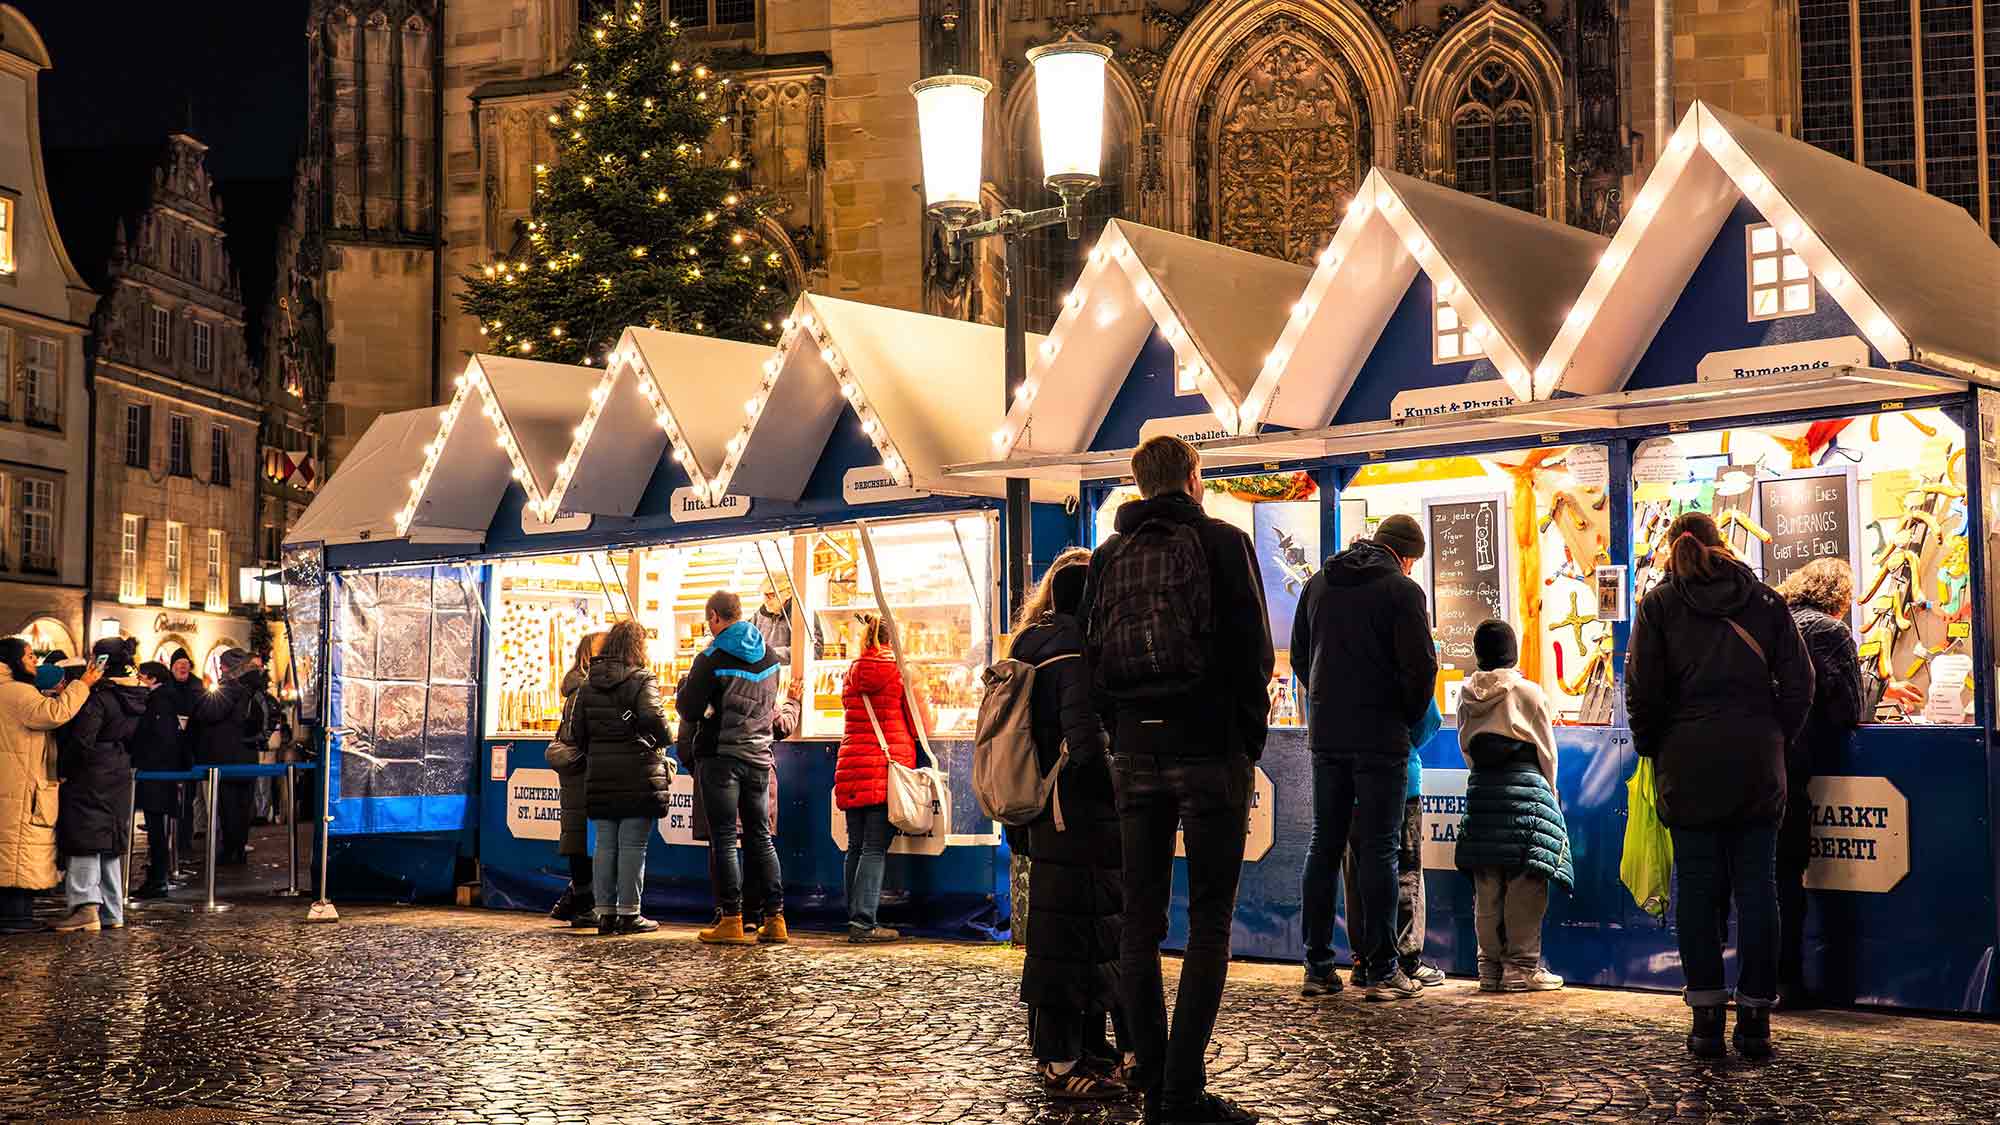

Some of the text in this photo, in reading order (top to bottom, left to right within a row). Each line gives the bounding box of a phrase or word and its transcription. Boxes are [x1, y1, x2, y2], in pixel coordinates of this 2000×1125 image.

[1404, 403, 1446, 418] Kunst
[1449, 402, 1460, 411] &
[518, 806, 532, 819] ST.
[671, 815, 685, 829] ST.
